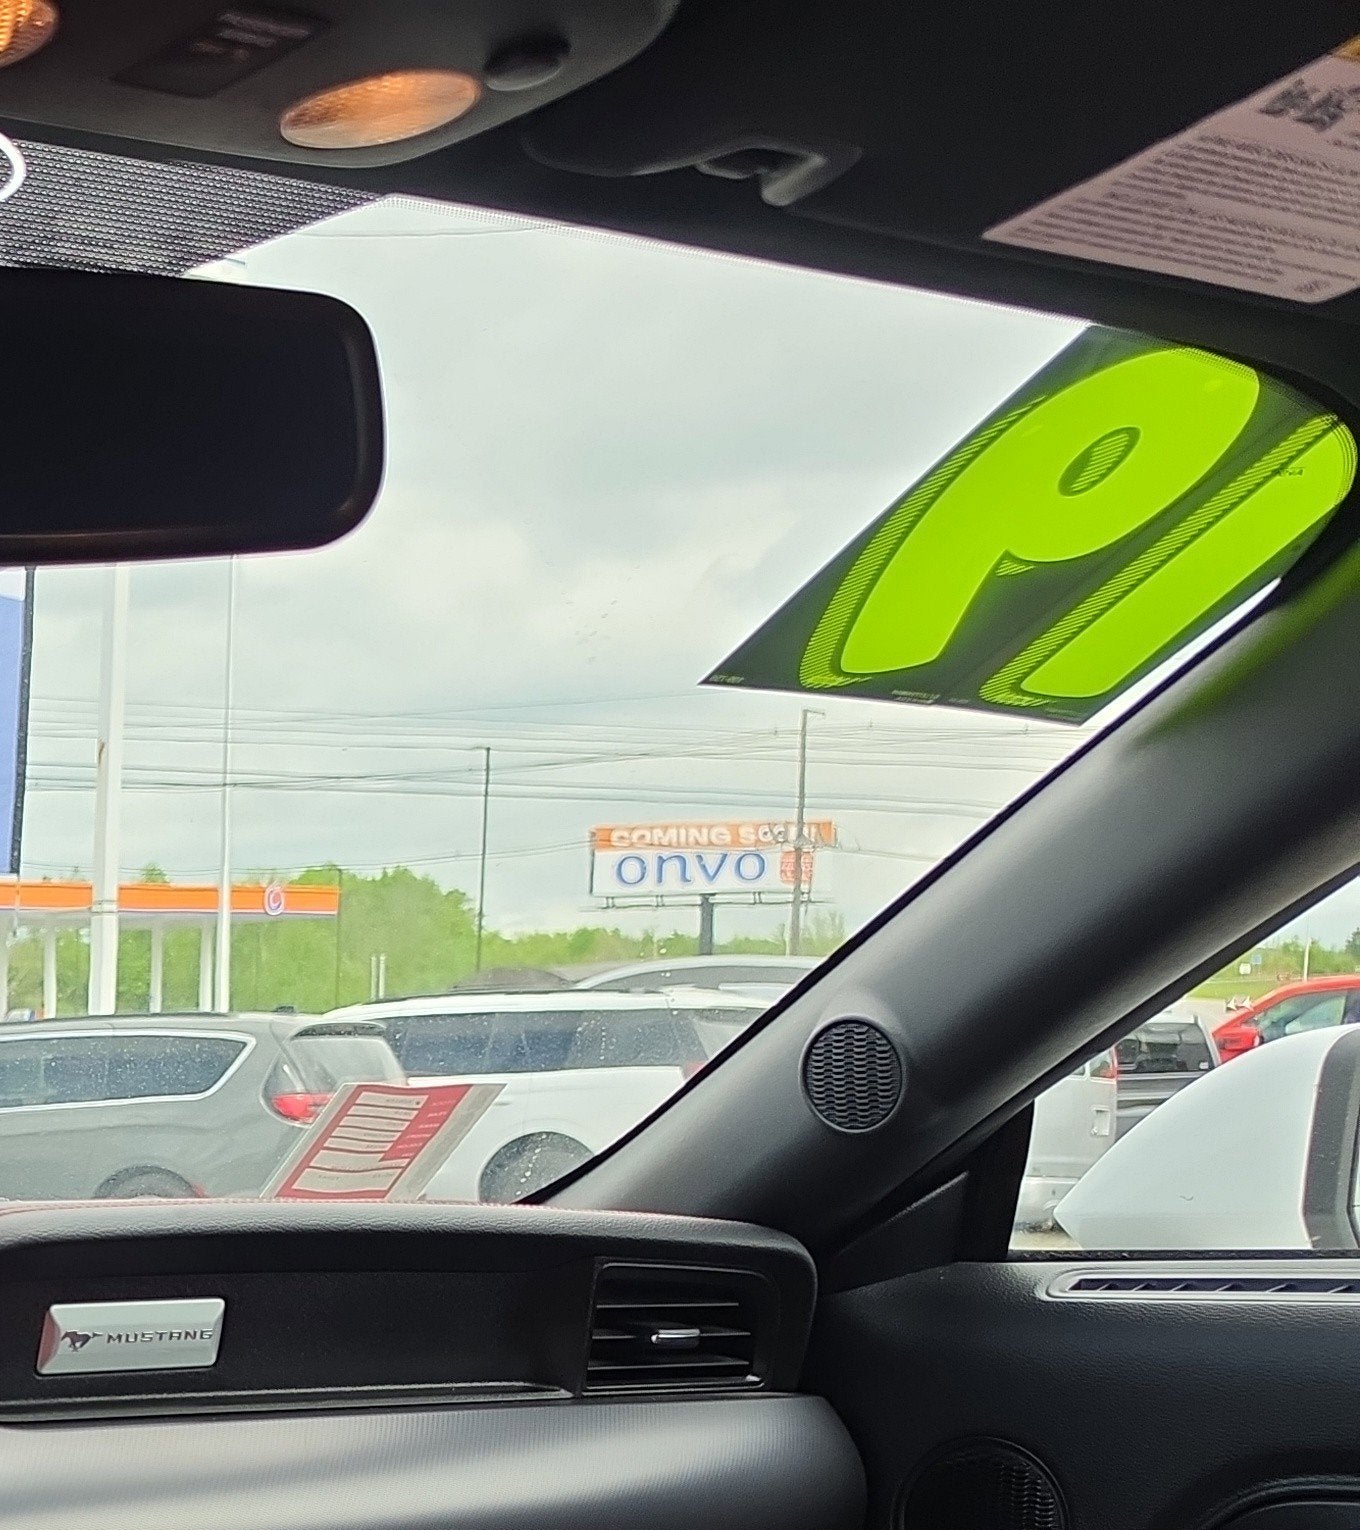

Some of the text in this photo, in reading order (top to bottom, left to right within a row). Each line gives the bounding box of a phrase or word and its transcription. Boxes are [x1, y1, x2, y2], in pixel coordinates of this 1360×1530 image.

[610, 826, 732, 848] COMING
[615, 852, 767, 887] onvo
[106, 1328, 214, 1345] MUSTANG
